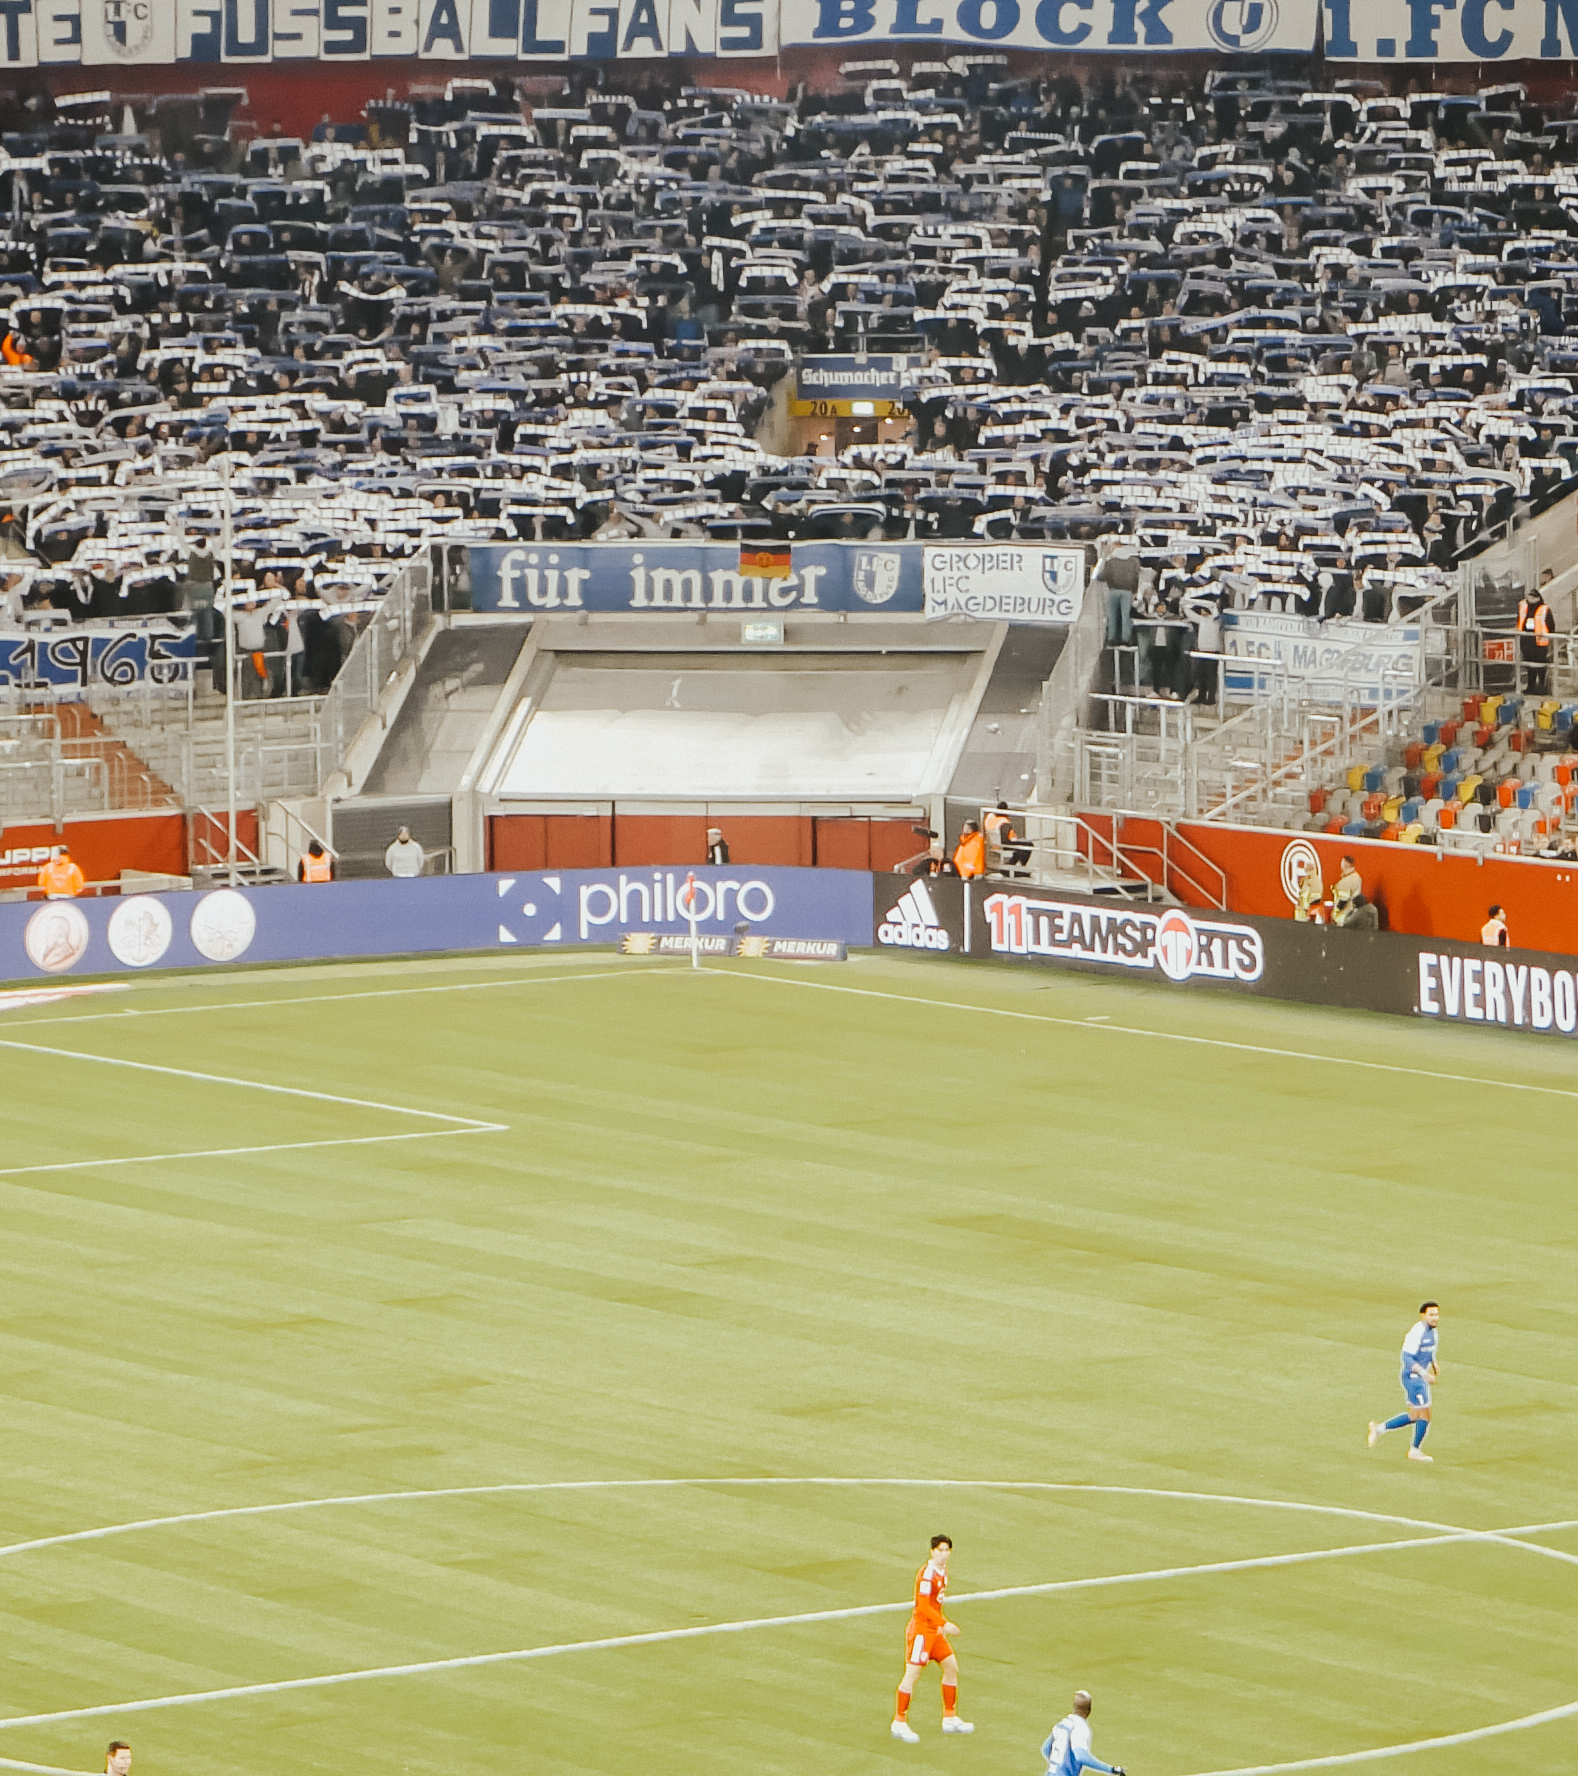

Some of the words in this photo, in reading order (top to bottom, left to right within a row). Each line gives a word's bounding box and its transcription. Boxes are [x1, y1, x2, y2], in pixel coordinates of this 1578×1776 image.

[801, 368, 896, 387] Schumacher
[497, 548, 591, 608] für
[629, 553, 827, 609] immer
[931, 595, 1074, 616] MAGDEBURG
[9, 633, 185, 688] 1965
[580, 872, 775, 940] philoro
[773, 939, 838, 956] MERKUR
[878, 922, 950, 951] adidas
